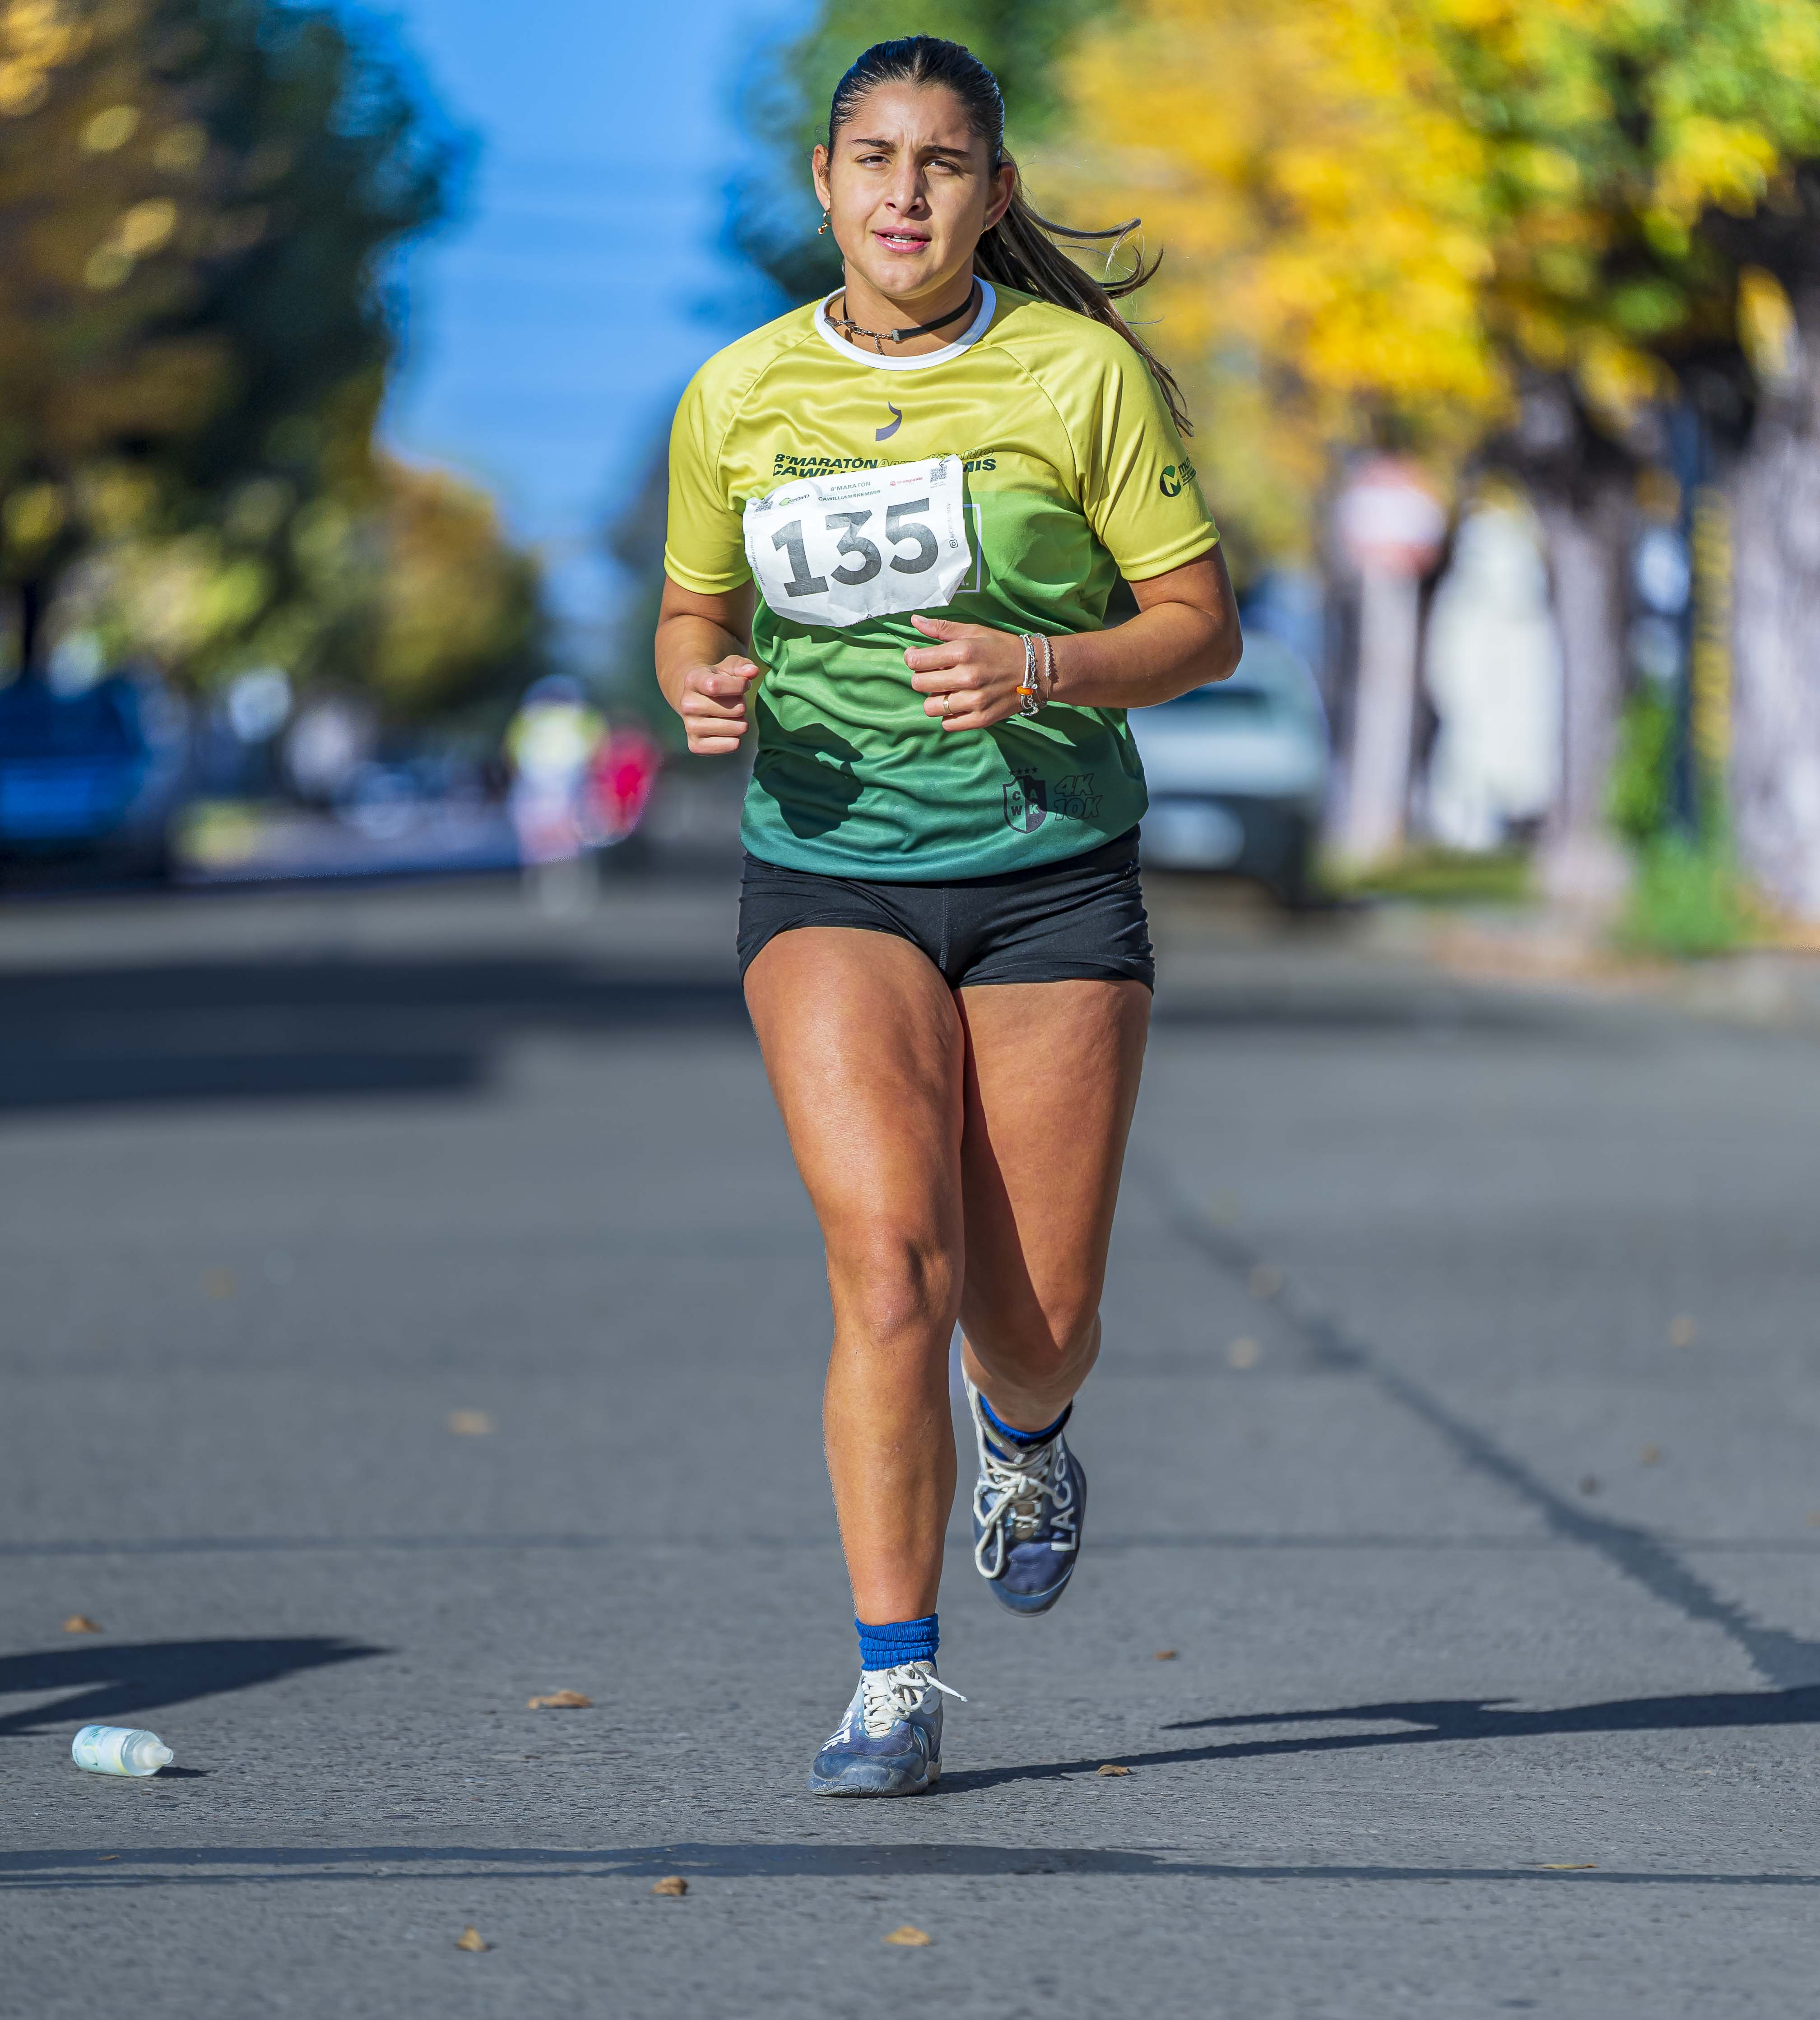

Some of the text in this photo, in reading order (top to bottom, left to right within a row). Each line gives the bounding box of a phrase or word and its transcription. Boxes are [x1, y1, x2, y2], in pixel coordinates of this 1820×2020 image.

[774, 454, 878, 468] 8°MARATÓN
[818, 490, 881, 501] CAWILLIAMSKEMMIS
[771, 497, 939, 598] 135
[1054, 773, 1095, 797] 4K
[1054, 795, 1103, 821] 10K
